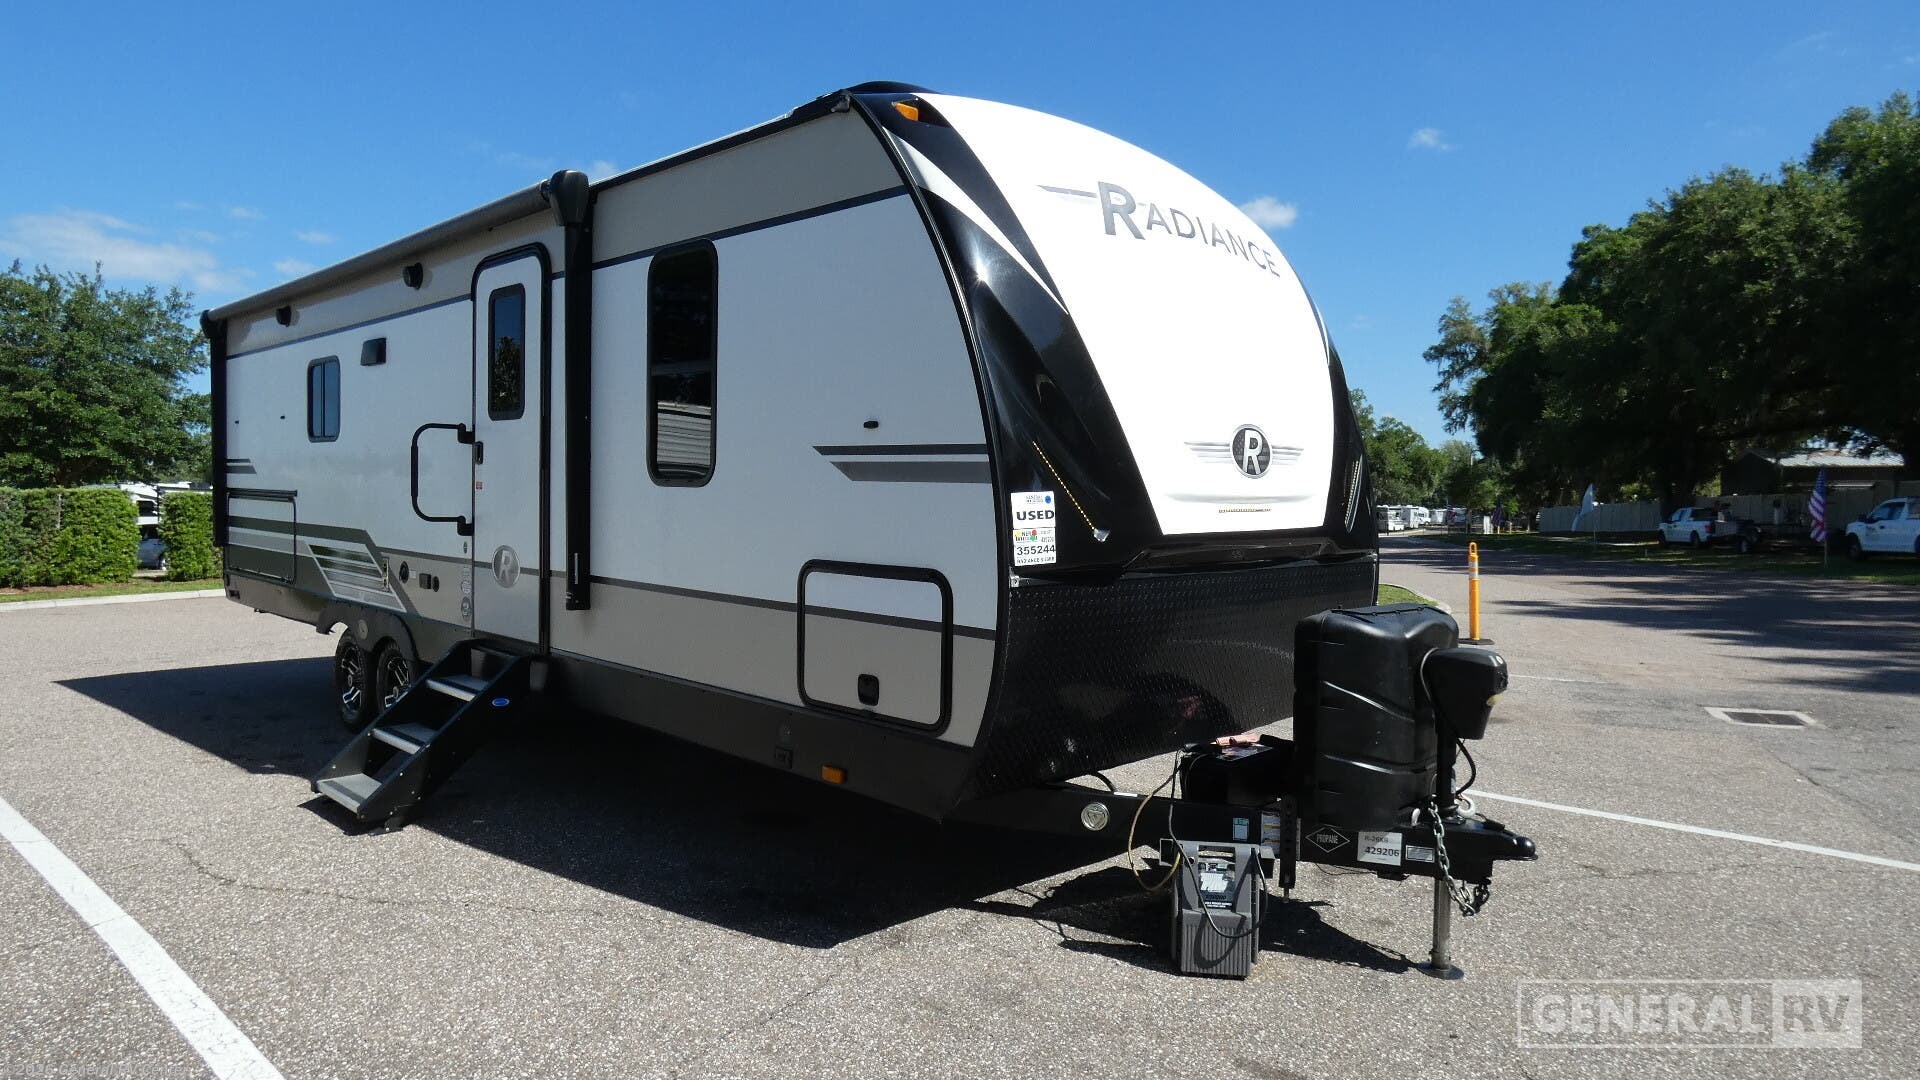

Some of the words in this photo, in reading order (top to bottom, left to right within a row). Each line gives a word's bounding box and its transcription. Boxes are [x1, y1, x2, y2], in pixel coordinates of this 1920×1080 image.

[1097, 181, 1280, 278] RADIANCE
[1242, 429, 1263, 475] R
[1016, 510, 1055, 521] USED
[1016, 545, 1056, 556] 355244
[1316, 833, 1339, 844] PROPANE
[1364, 846, 1400, 857] 429206
